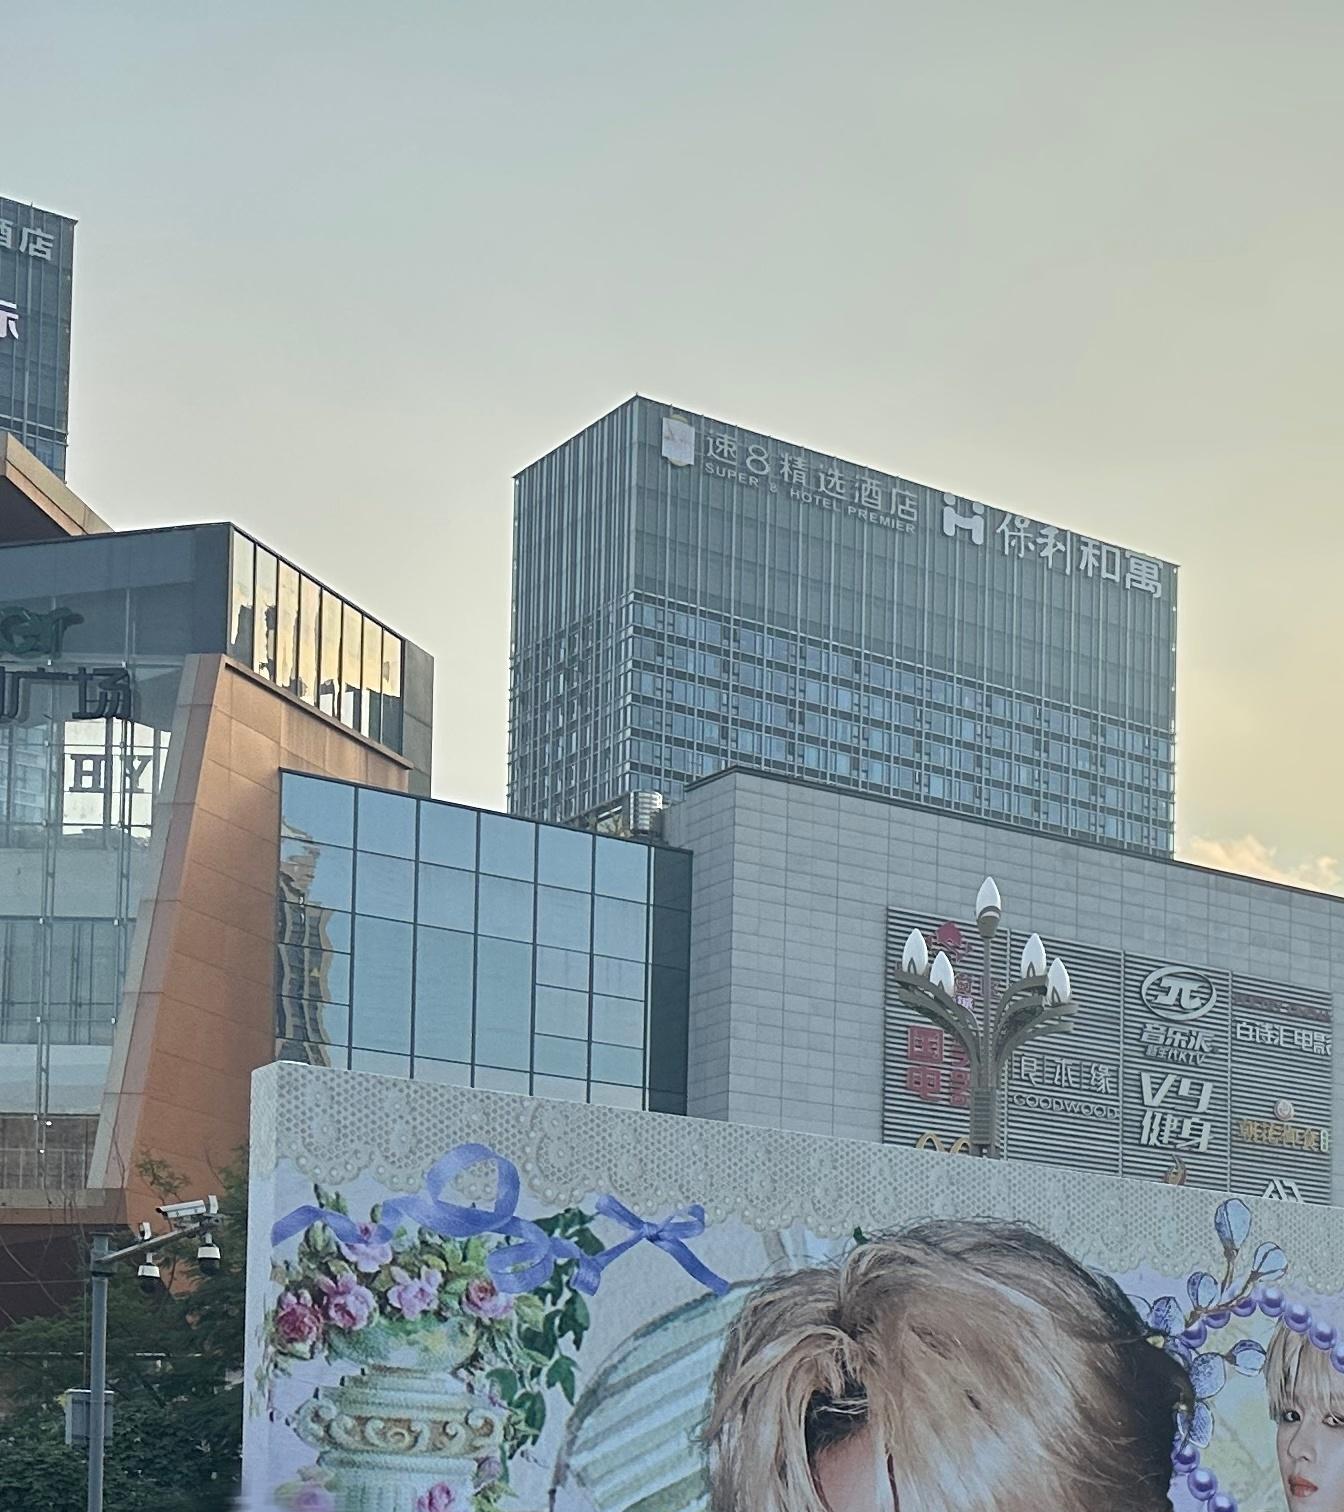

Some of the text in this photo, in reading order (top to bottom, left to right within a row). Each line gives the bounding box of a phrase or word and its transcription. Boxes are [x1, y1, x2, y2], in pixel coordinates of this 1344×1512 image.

[704, 462, 760, 488] SUPER
[790, 489, 841, 512] HOTEL
[847, 506, 916, 534] PREMIER
[706, 433, 918, 521] 速8精选酒店
[1141, 1023, 1216, 1053] 音乐派
[1013, 1094, 1118, 1119] GOODWOOD
[1141, 1072, 1213, 1113] V9
[1140, 1109, 1214, 1153] 健身
